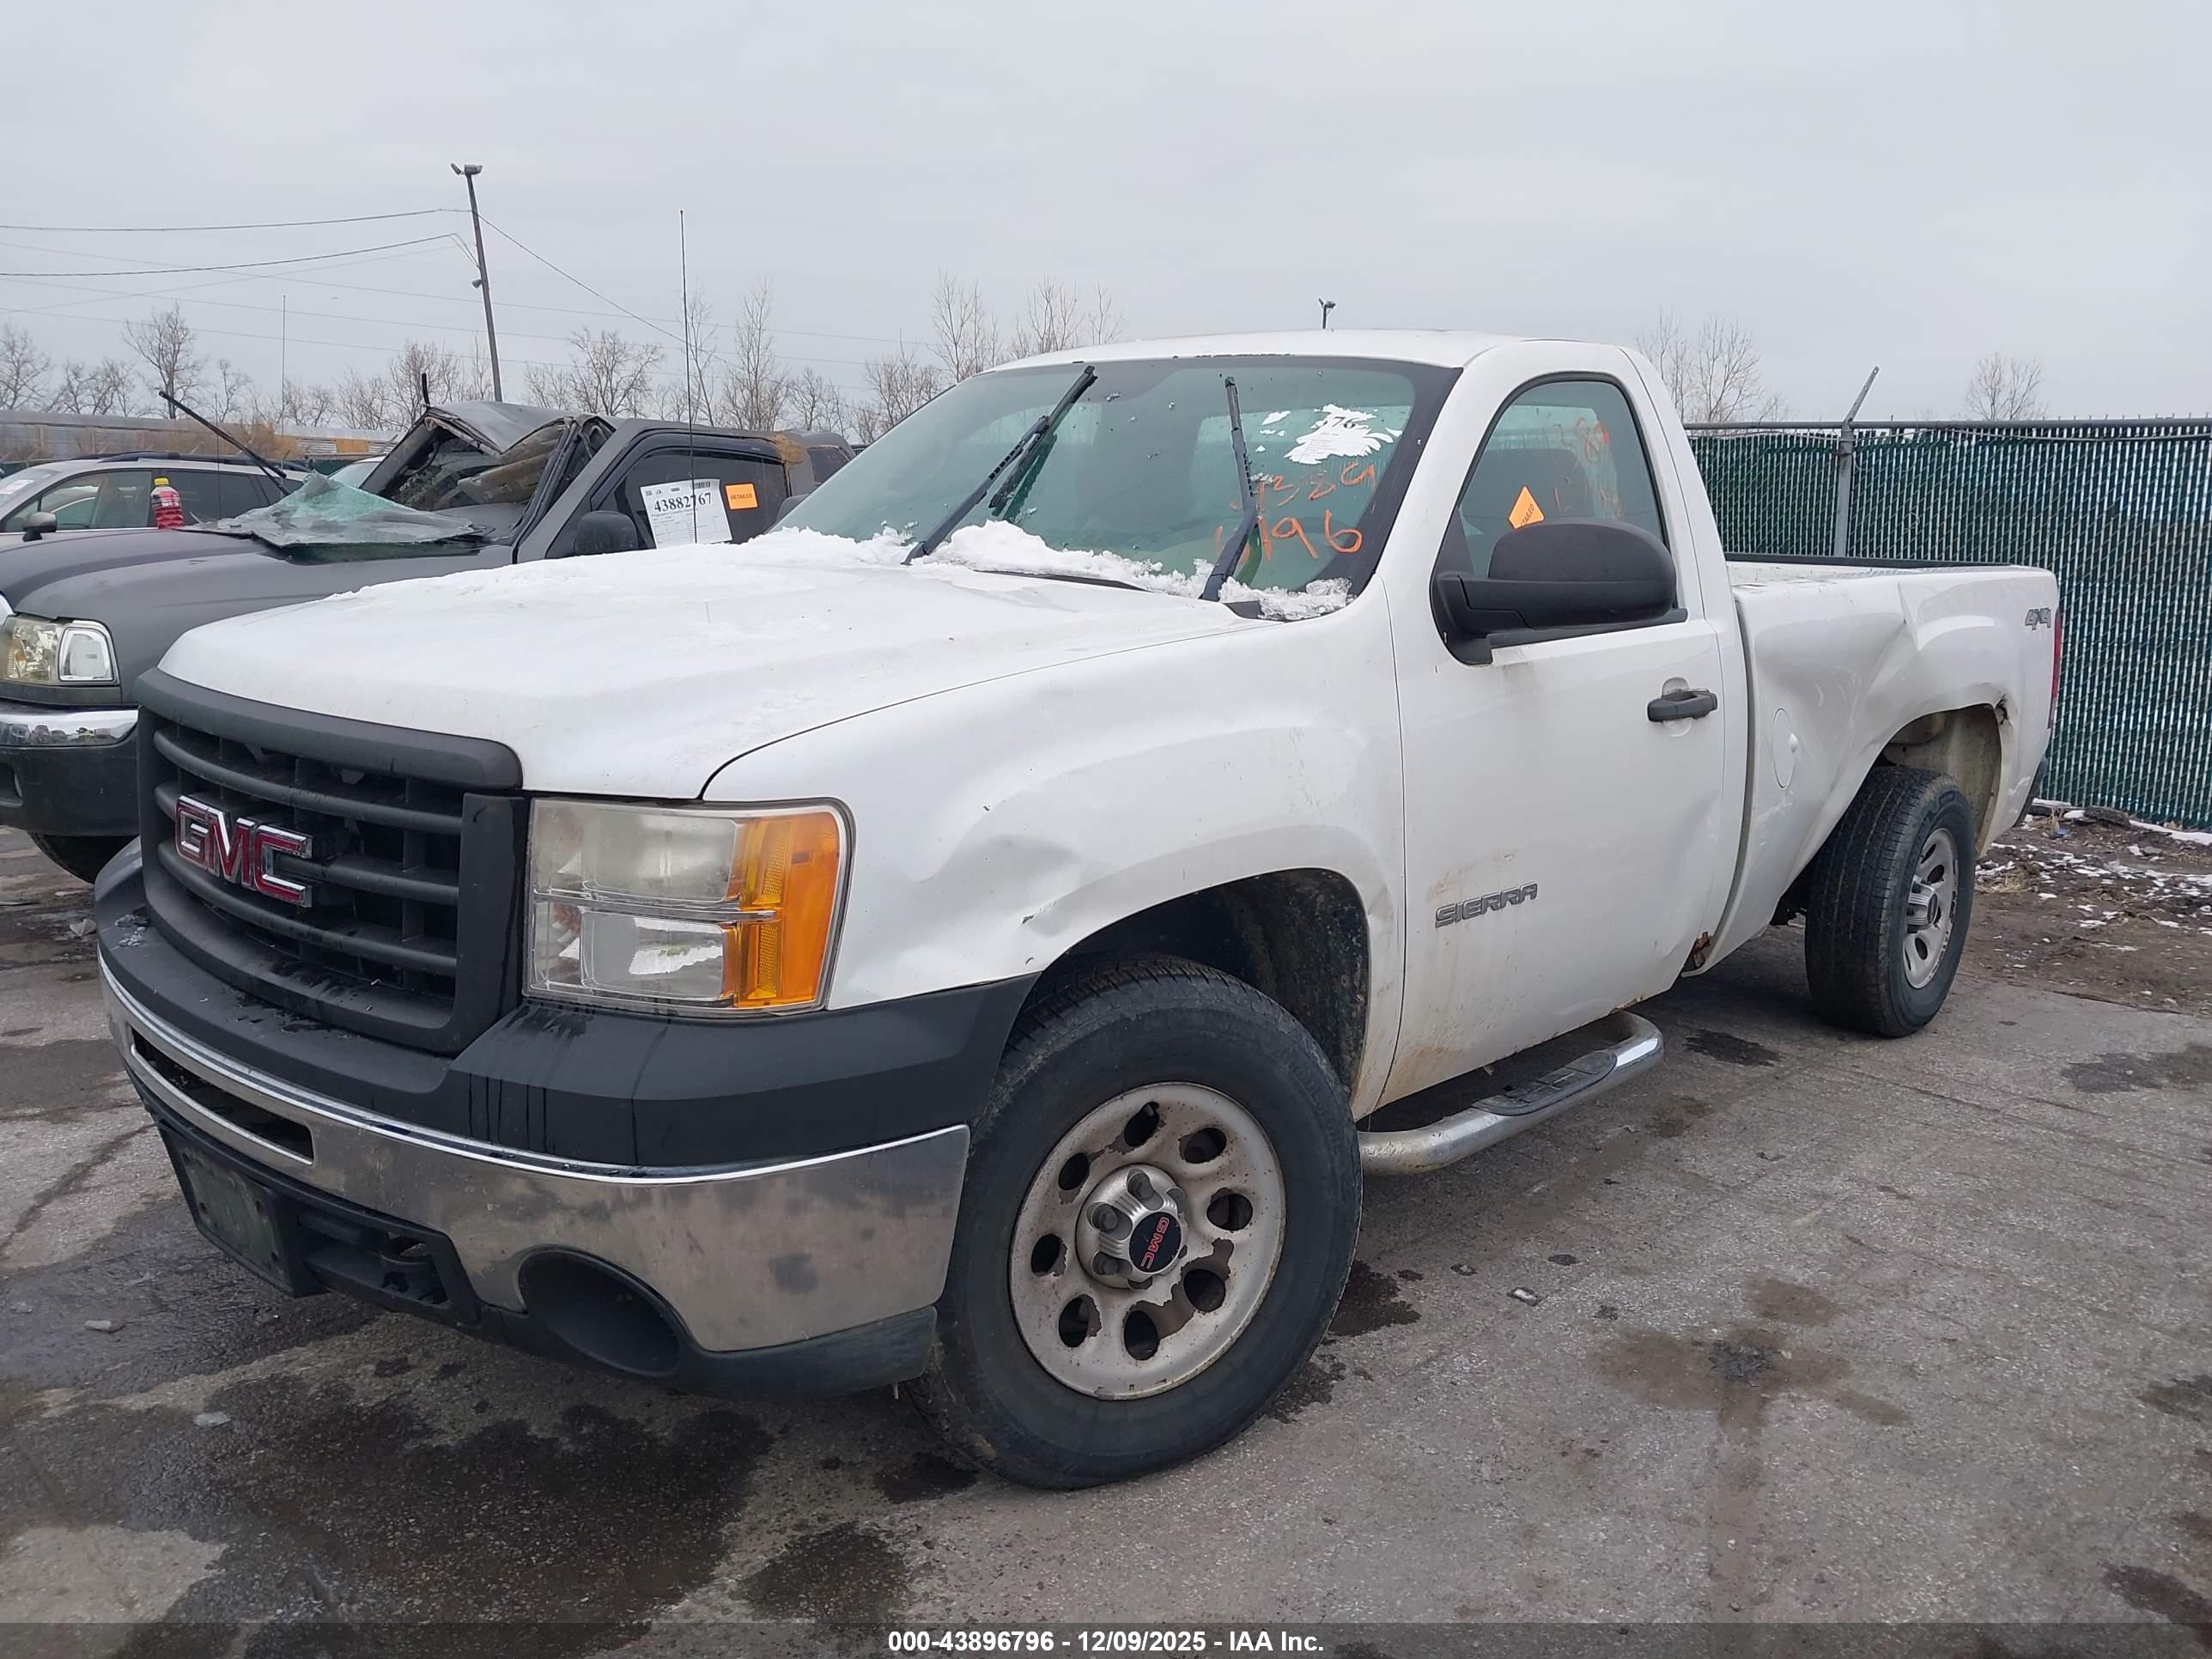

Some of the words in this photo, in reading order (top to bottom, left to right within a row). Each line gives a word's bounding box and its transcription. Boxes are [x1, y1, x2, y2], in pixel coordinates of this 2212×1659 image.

[653, 492, 711, 512] 43882767
[175, 794, 313, 908] GMC
[1435, 882, 1539, 928] SIERRA
[1140, 1217, 1170, 1269] GMC
